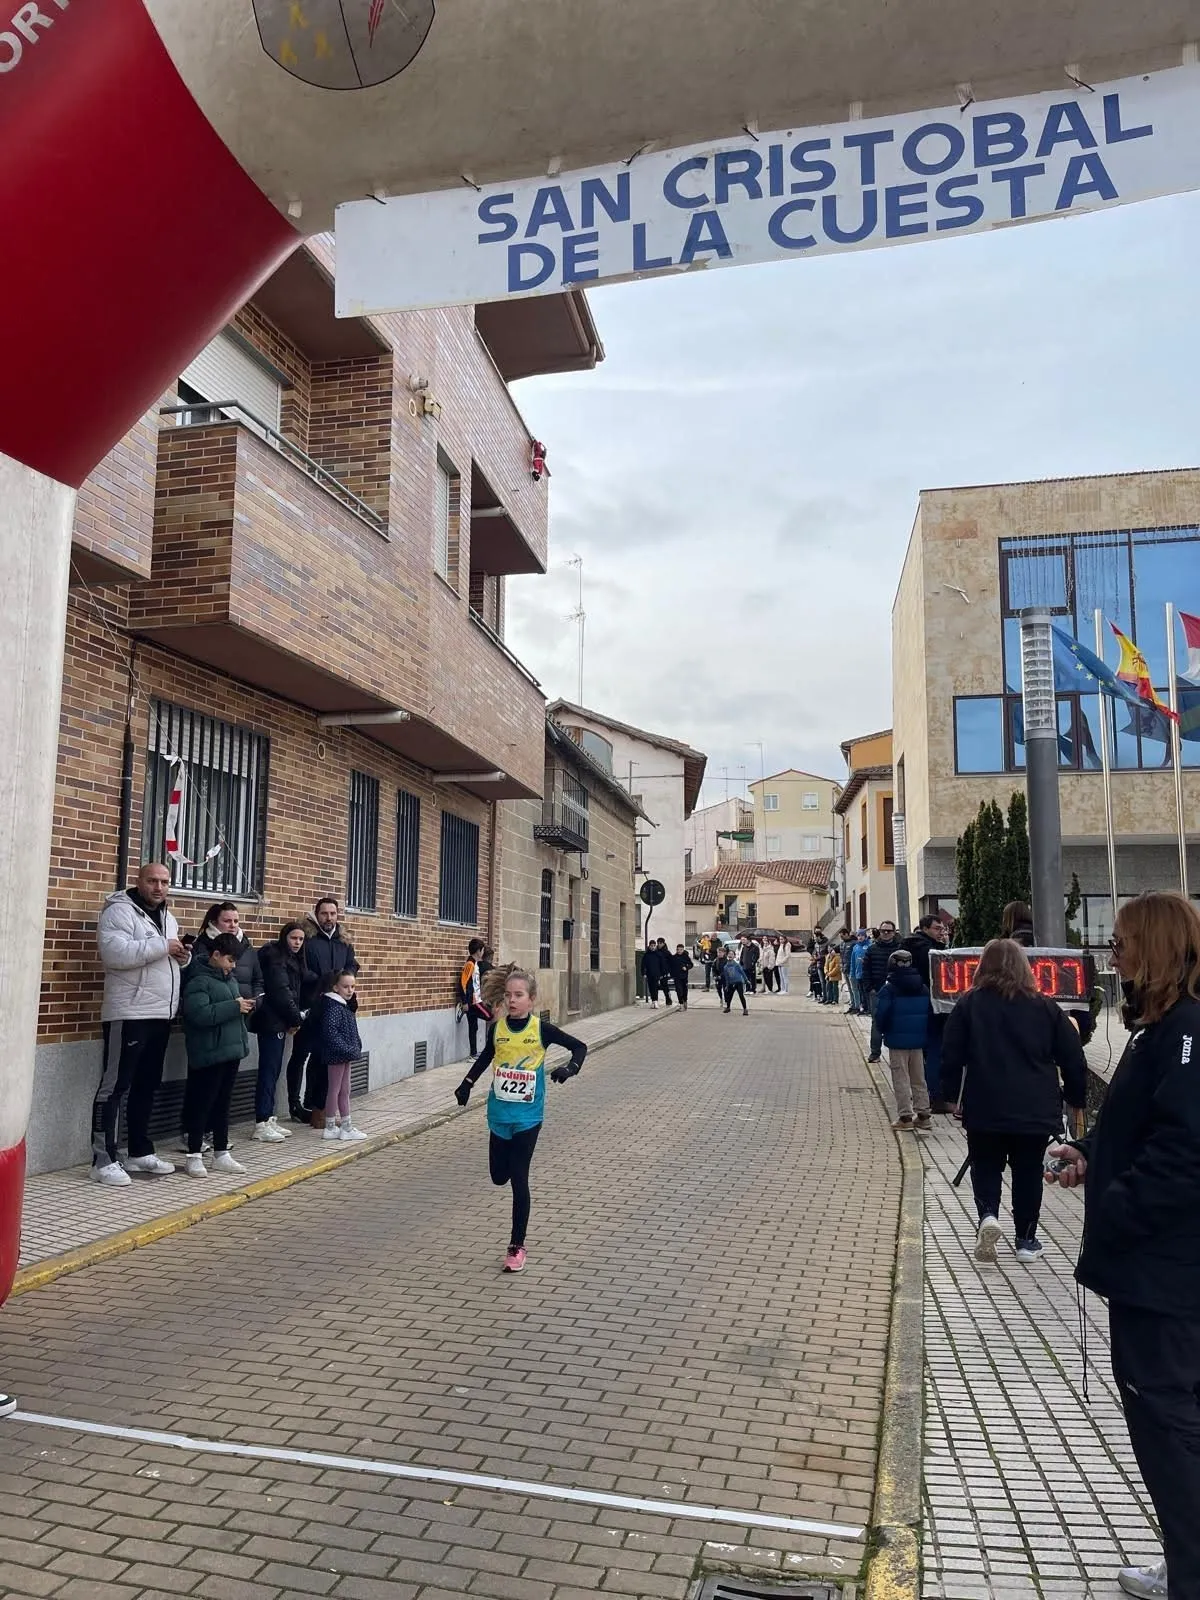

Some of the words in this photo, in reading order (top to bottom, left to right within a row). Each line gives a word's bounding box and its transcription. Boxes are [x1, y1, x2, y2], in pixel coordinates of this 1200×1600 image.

[0, 0, 70, 73] OR
[478, 172, 630, 244] SAN
[663, 94, 1153, 209] CRISTOBAL
[508, 231, 599, 293] DE
[632, 210, 733, 271] LA
[768, 152, 1119, 250] CUESTA
[1181, 1034, 1193, 1065] Joma
[501, 1080, 527, 1094] 422
